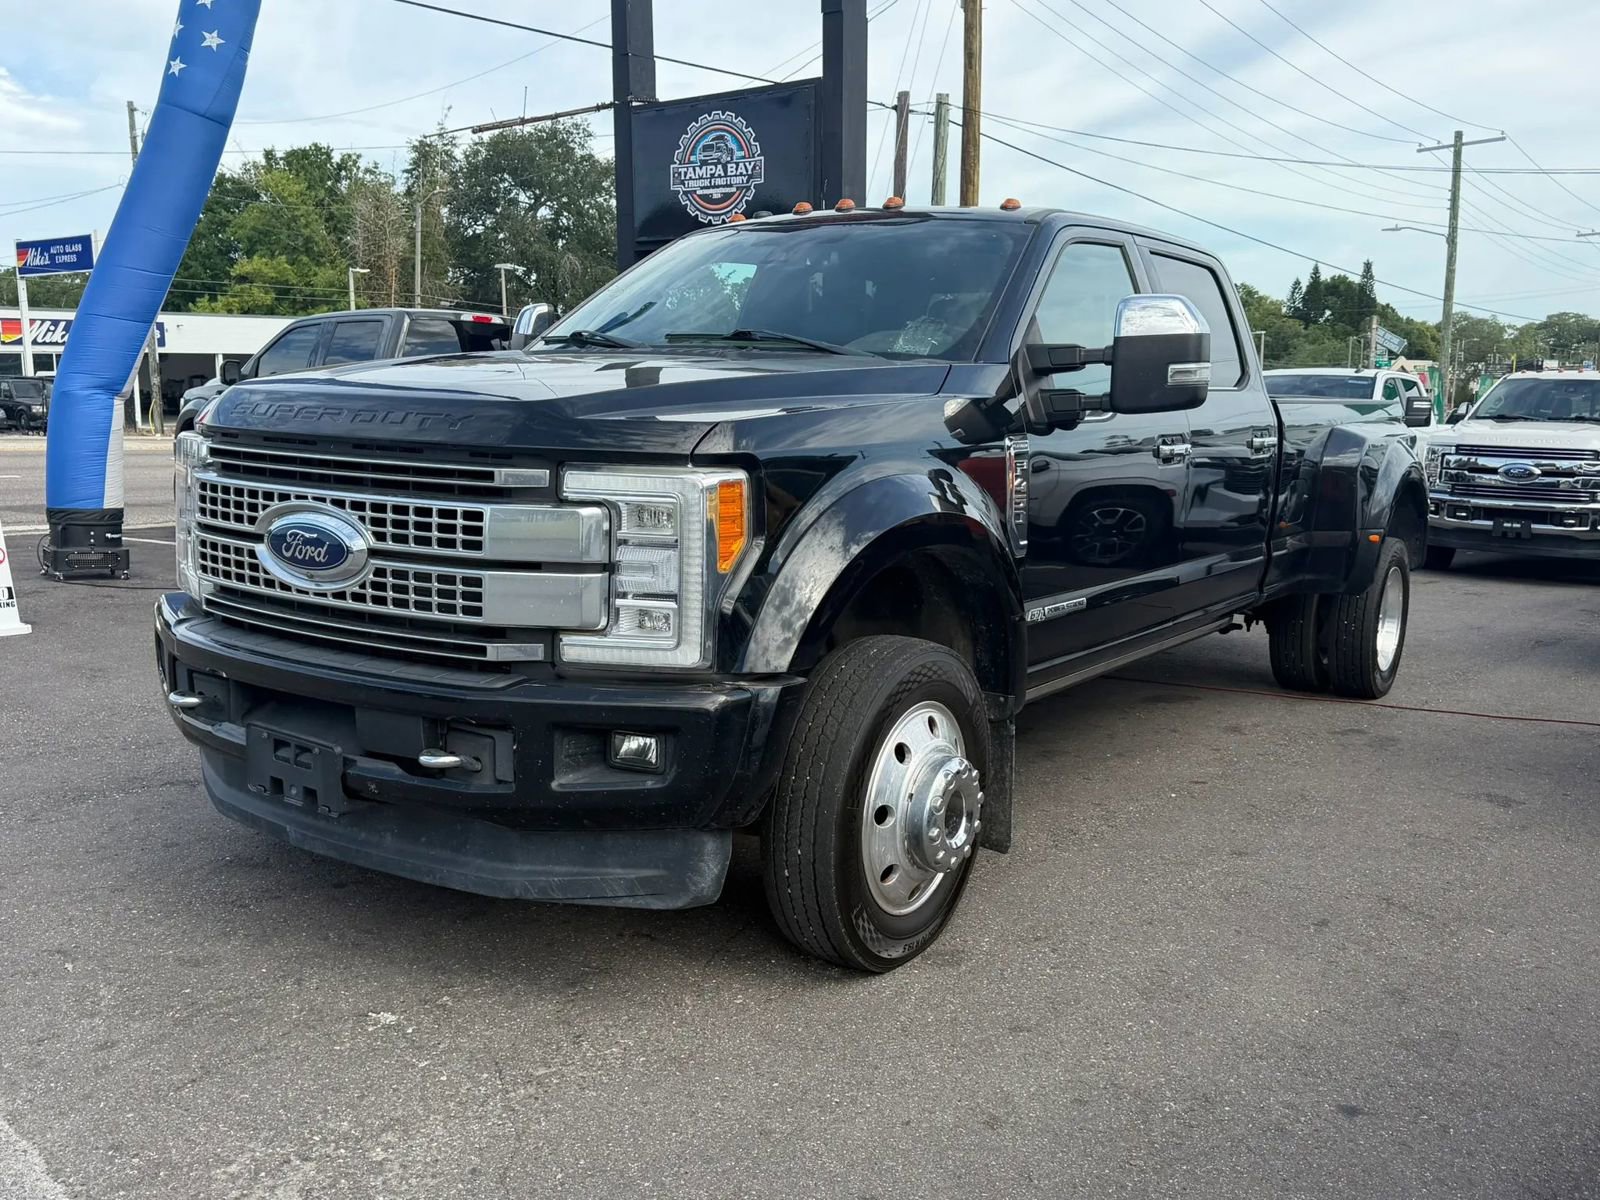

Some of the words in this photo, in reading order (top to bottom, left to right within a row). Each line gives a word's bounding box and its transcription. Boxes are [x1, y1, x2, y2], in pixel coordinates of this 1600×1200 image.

[678, 165, 725, 180] TAMPA
[727, 162, 755, 176] BAY
[684, 179, 710, 188] TRUCK
[711, 176, 748, 186] FACTORY
[50, 245, 64, 254] AUTO
[65, 244, 82, 253] GLASS
[55, 255, 77, 263] EXPRESS
[30, 320, 69, 343] Mik
[230, 402, 348, 424] SUPER
[349, 409, 475, 429] DUTY
[282, 528, 330, 563] Ford
